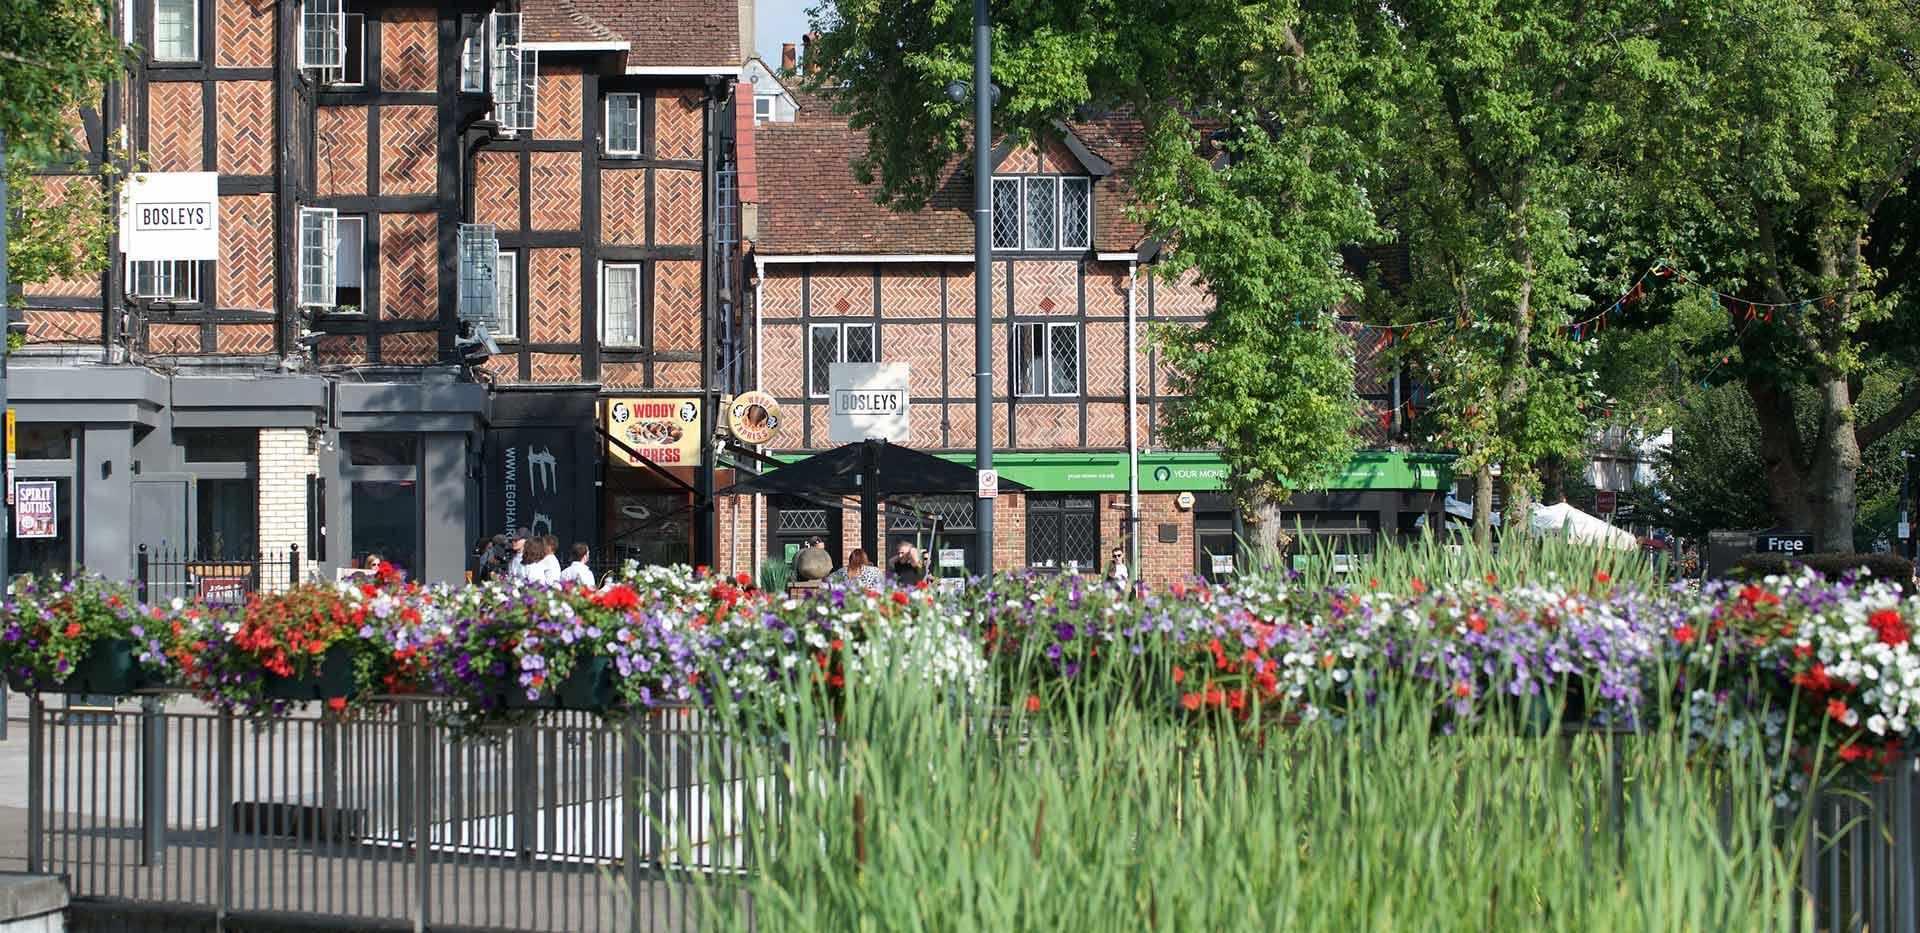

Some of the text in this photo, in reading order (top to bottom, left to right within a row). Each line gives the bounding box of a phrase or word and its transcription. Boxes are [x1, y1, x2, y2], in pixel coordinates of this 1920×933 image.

[143, 207, 204, 225] BOSLEYS
[842, 394, 897, 410] BOSLEYS
[634, 403, 675, 418] WOODY
[1174, 470, 1225, 479] YOUR MOVE
[20, 488, 51, 500] SPIRIT
[20, 502, 52, 513] BOTTLES
[1768, 537, 1804, 551] Free
